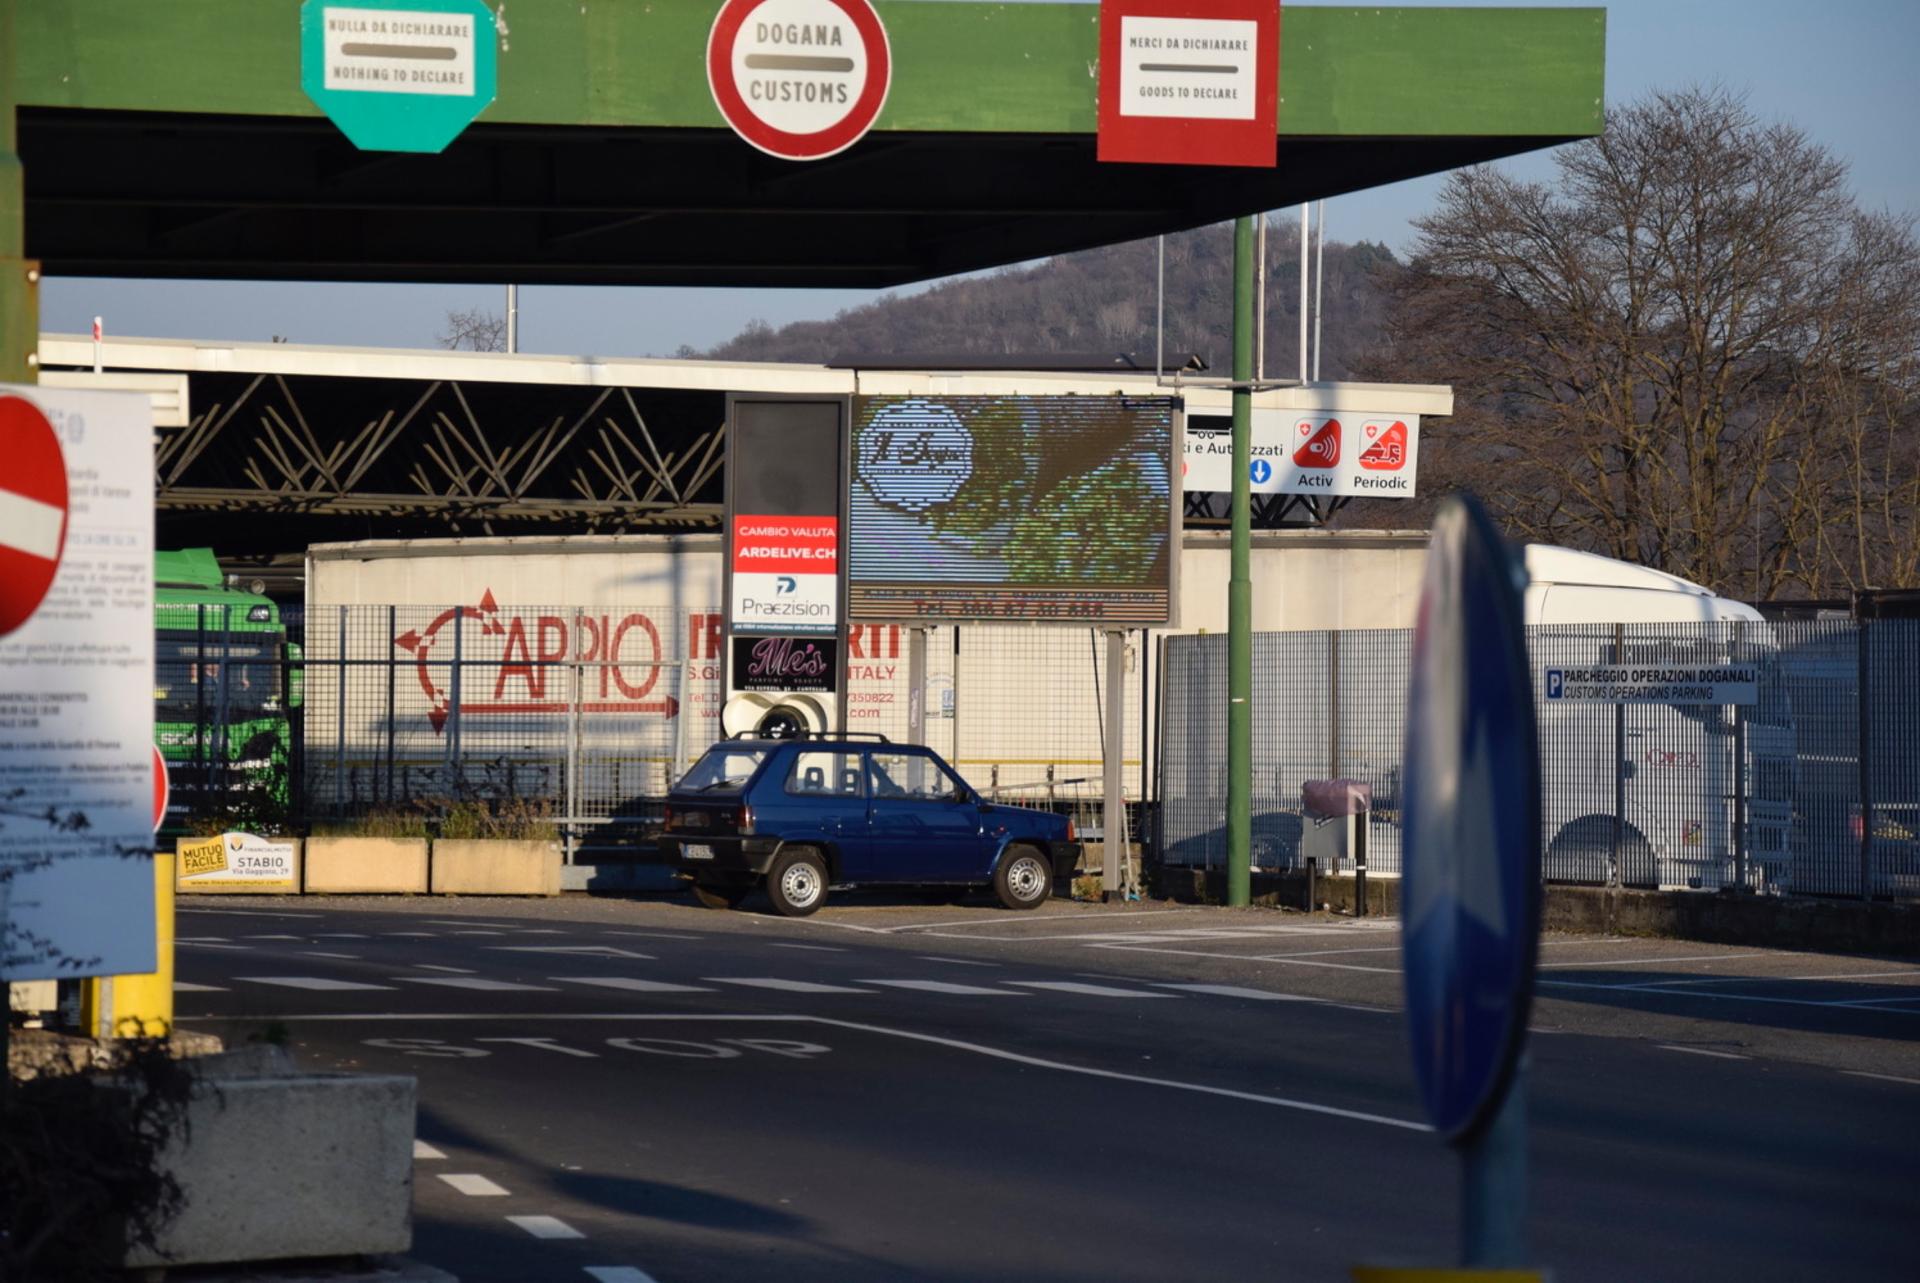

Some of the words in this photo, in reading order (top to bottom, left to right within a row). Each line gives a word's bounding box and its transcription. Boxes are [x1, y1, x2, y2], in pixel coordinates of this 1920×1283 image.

[329, 20, 367, 32] NULLA
[371, 21, 387, 33] DA
[391, 22, 469, 38] DICHIARARE
[756, 22, 842, 46] DOGANA
[1130, 37, 1162, 48] MERCI
[1166, 38, 1179, 49] DA
[1183, 38, 1248, 51] DICHIARARE
[333, 67, 389, 81] NOTHING
[394, 70, 407, 81] TO
[412, 71, 464, 84] DECLARE
[750, 80, 847, 103] CUSTOMS
[1140, 86, 1174, 98] GOODS
[1178, 87, 1190, 98] TO
[1193, 88, 1238, 99] DECLARE
[1207, 442, 1283, 456] Autzzati
[1298, 474, 1333, 487] Activ
[1354, 475, 1407, 488] Periodic
[739, 526, 790, 537] CAMBIO
[791, 527, 835, 537] VALUTA
[739, 547, 836, 559] ARDELIVE.CH
[1563, 669, 1627, 683] PARCHEGGIO
[1631, 669, 1696, 683] OPERAZIONI
[1699, 669, 1755, 683] DOGANALI
[1564, 686, 1607, 698] CUSTOMS
[1609, 686, 1670, 699] OPERATIONS
[1671, 686, 1713, 699] PARKING
[183, 844, 223, 860] MUTUO
[185, 854, 225, 869] FACILE
[238, 857, 284, 868] STABIO
